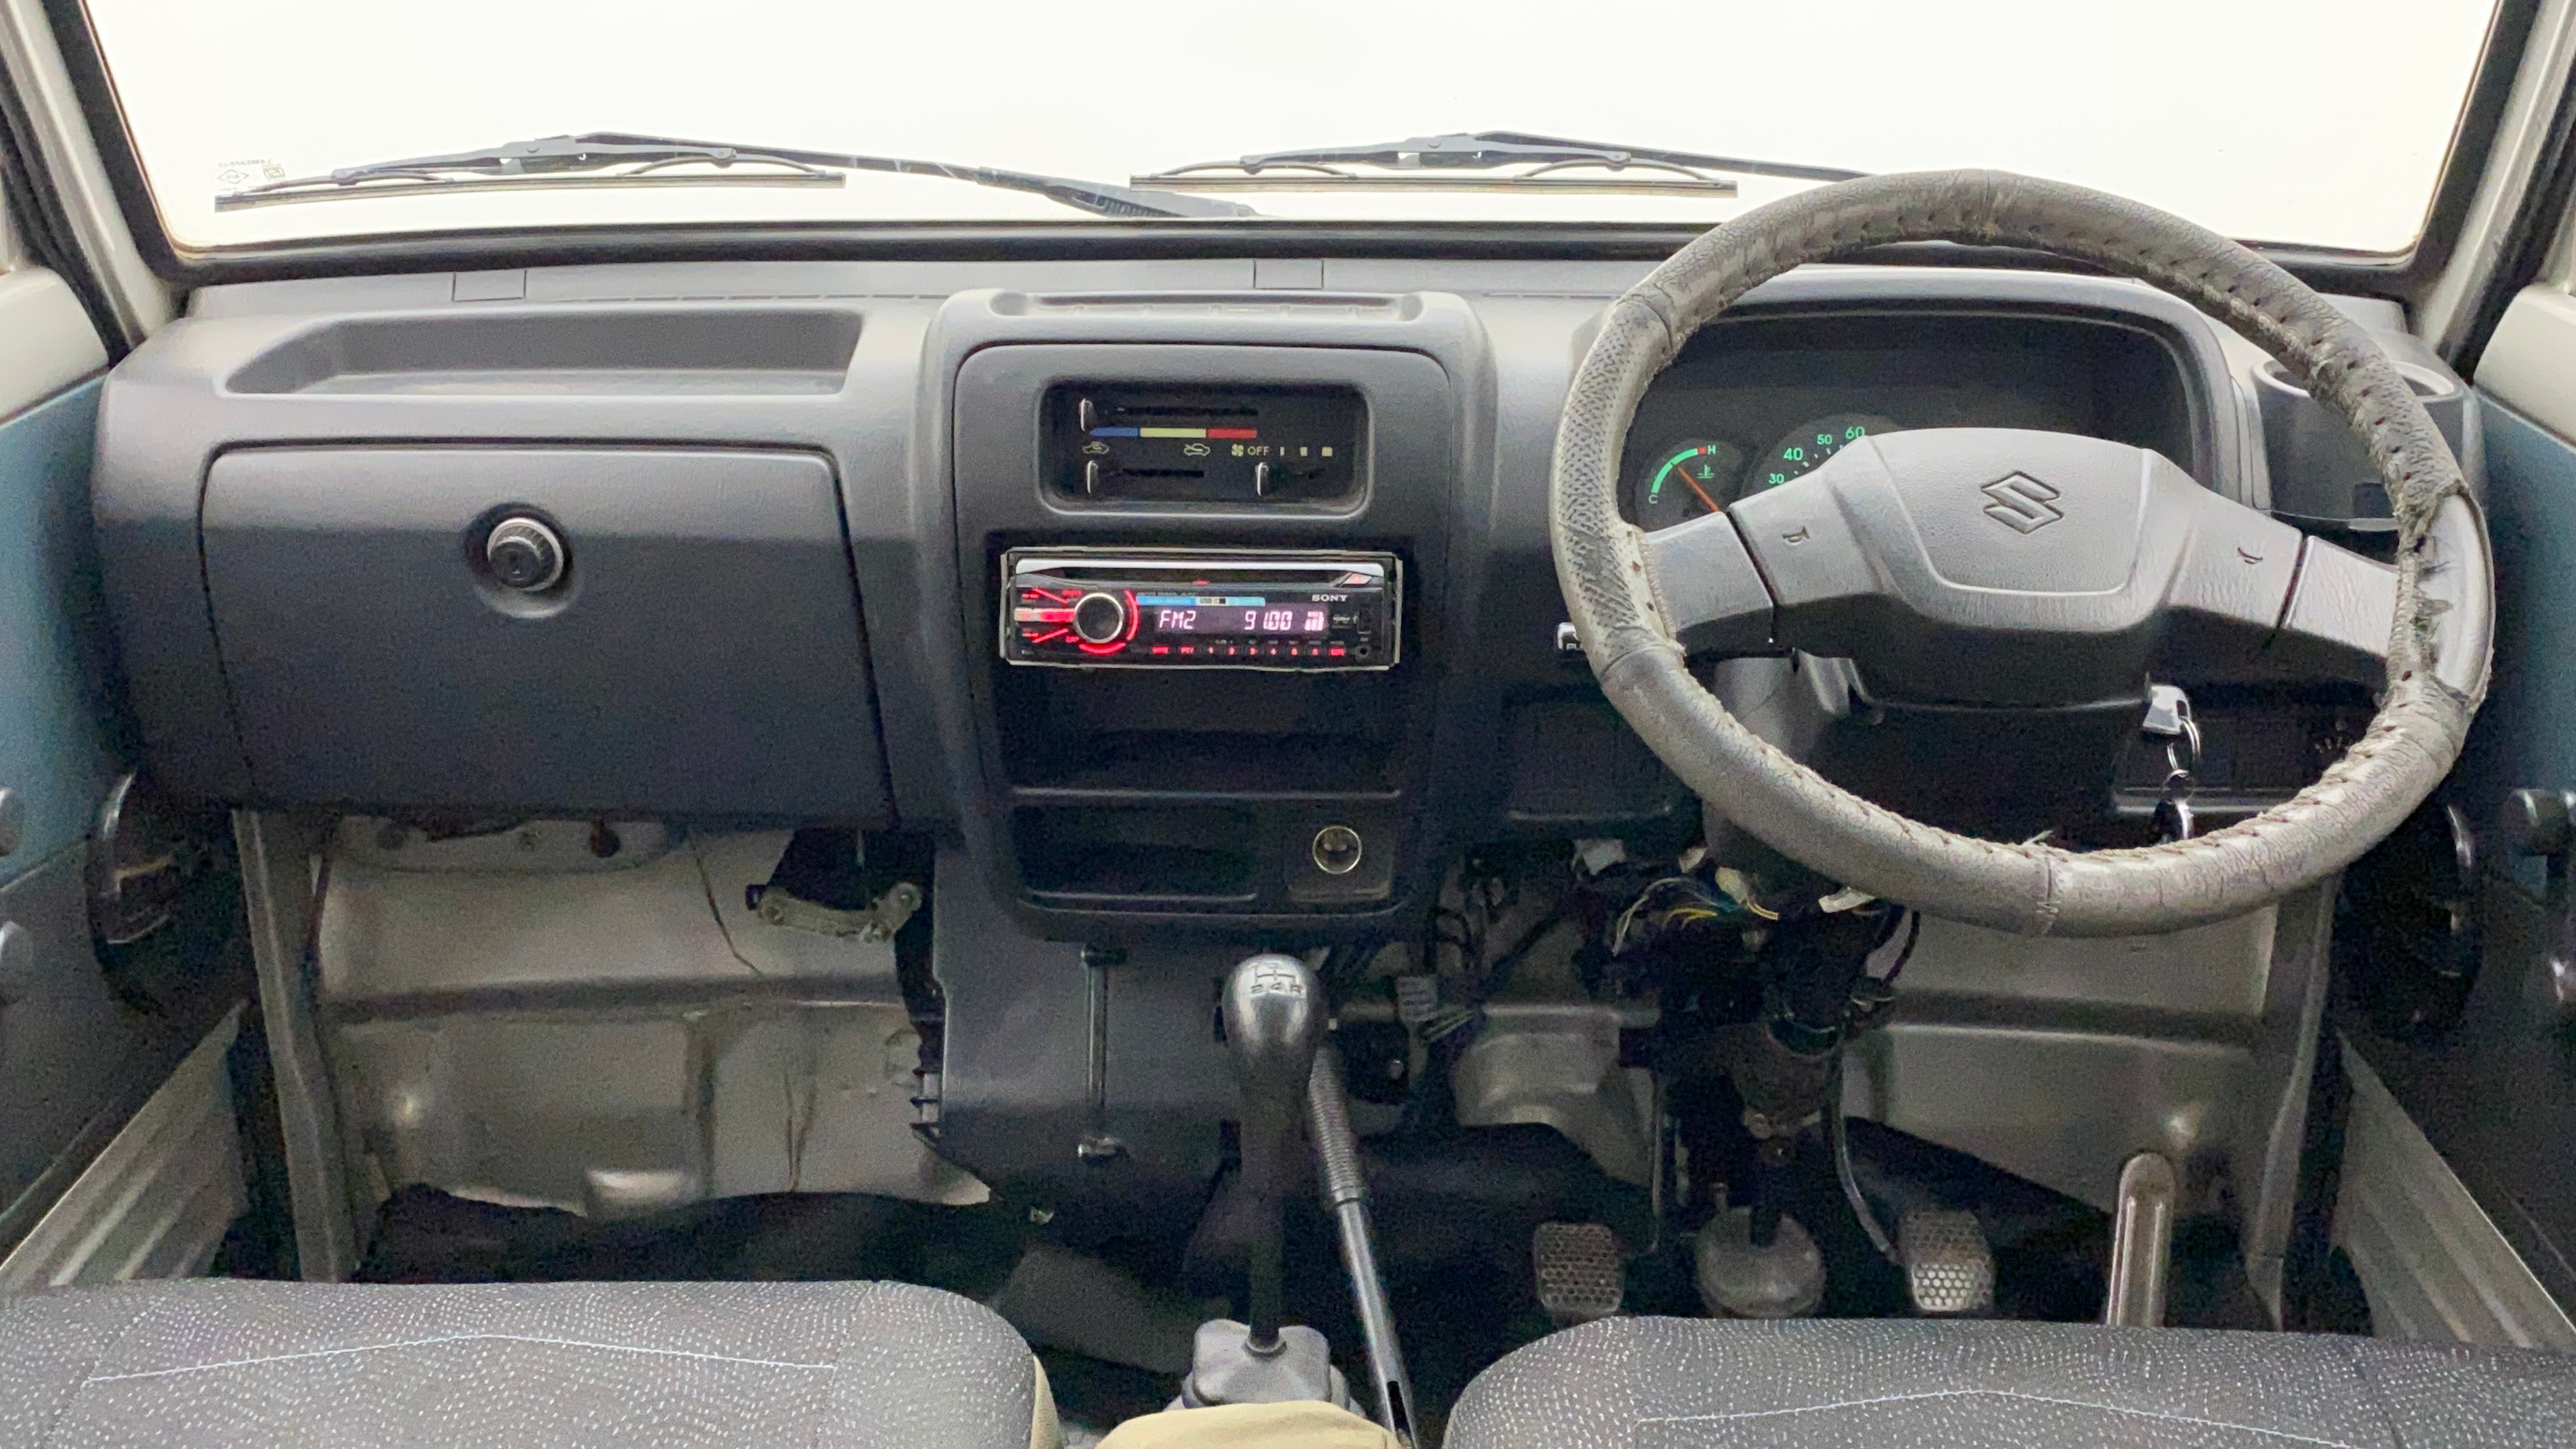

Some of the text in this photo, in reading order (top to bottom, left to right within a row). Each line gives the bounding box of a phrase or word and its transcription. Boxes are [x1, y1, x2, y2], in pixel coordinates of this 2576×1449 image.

[1845, 426, 1865, 439] 60
[1817, 434, 1832, 445] 50
[1247, 446, 1269, 456] OFF
[1708, 445, 1716, 454] H
[1783, 447, 1803, 460] 40
[1769, 473, 1784, 484] 30
[1648, 494, 1658, 504] C
[1159, 610, 1197, 630] FM2
